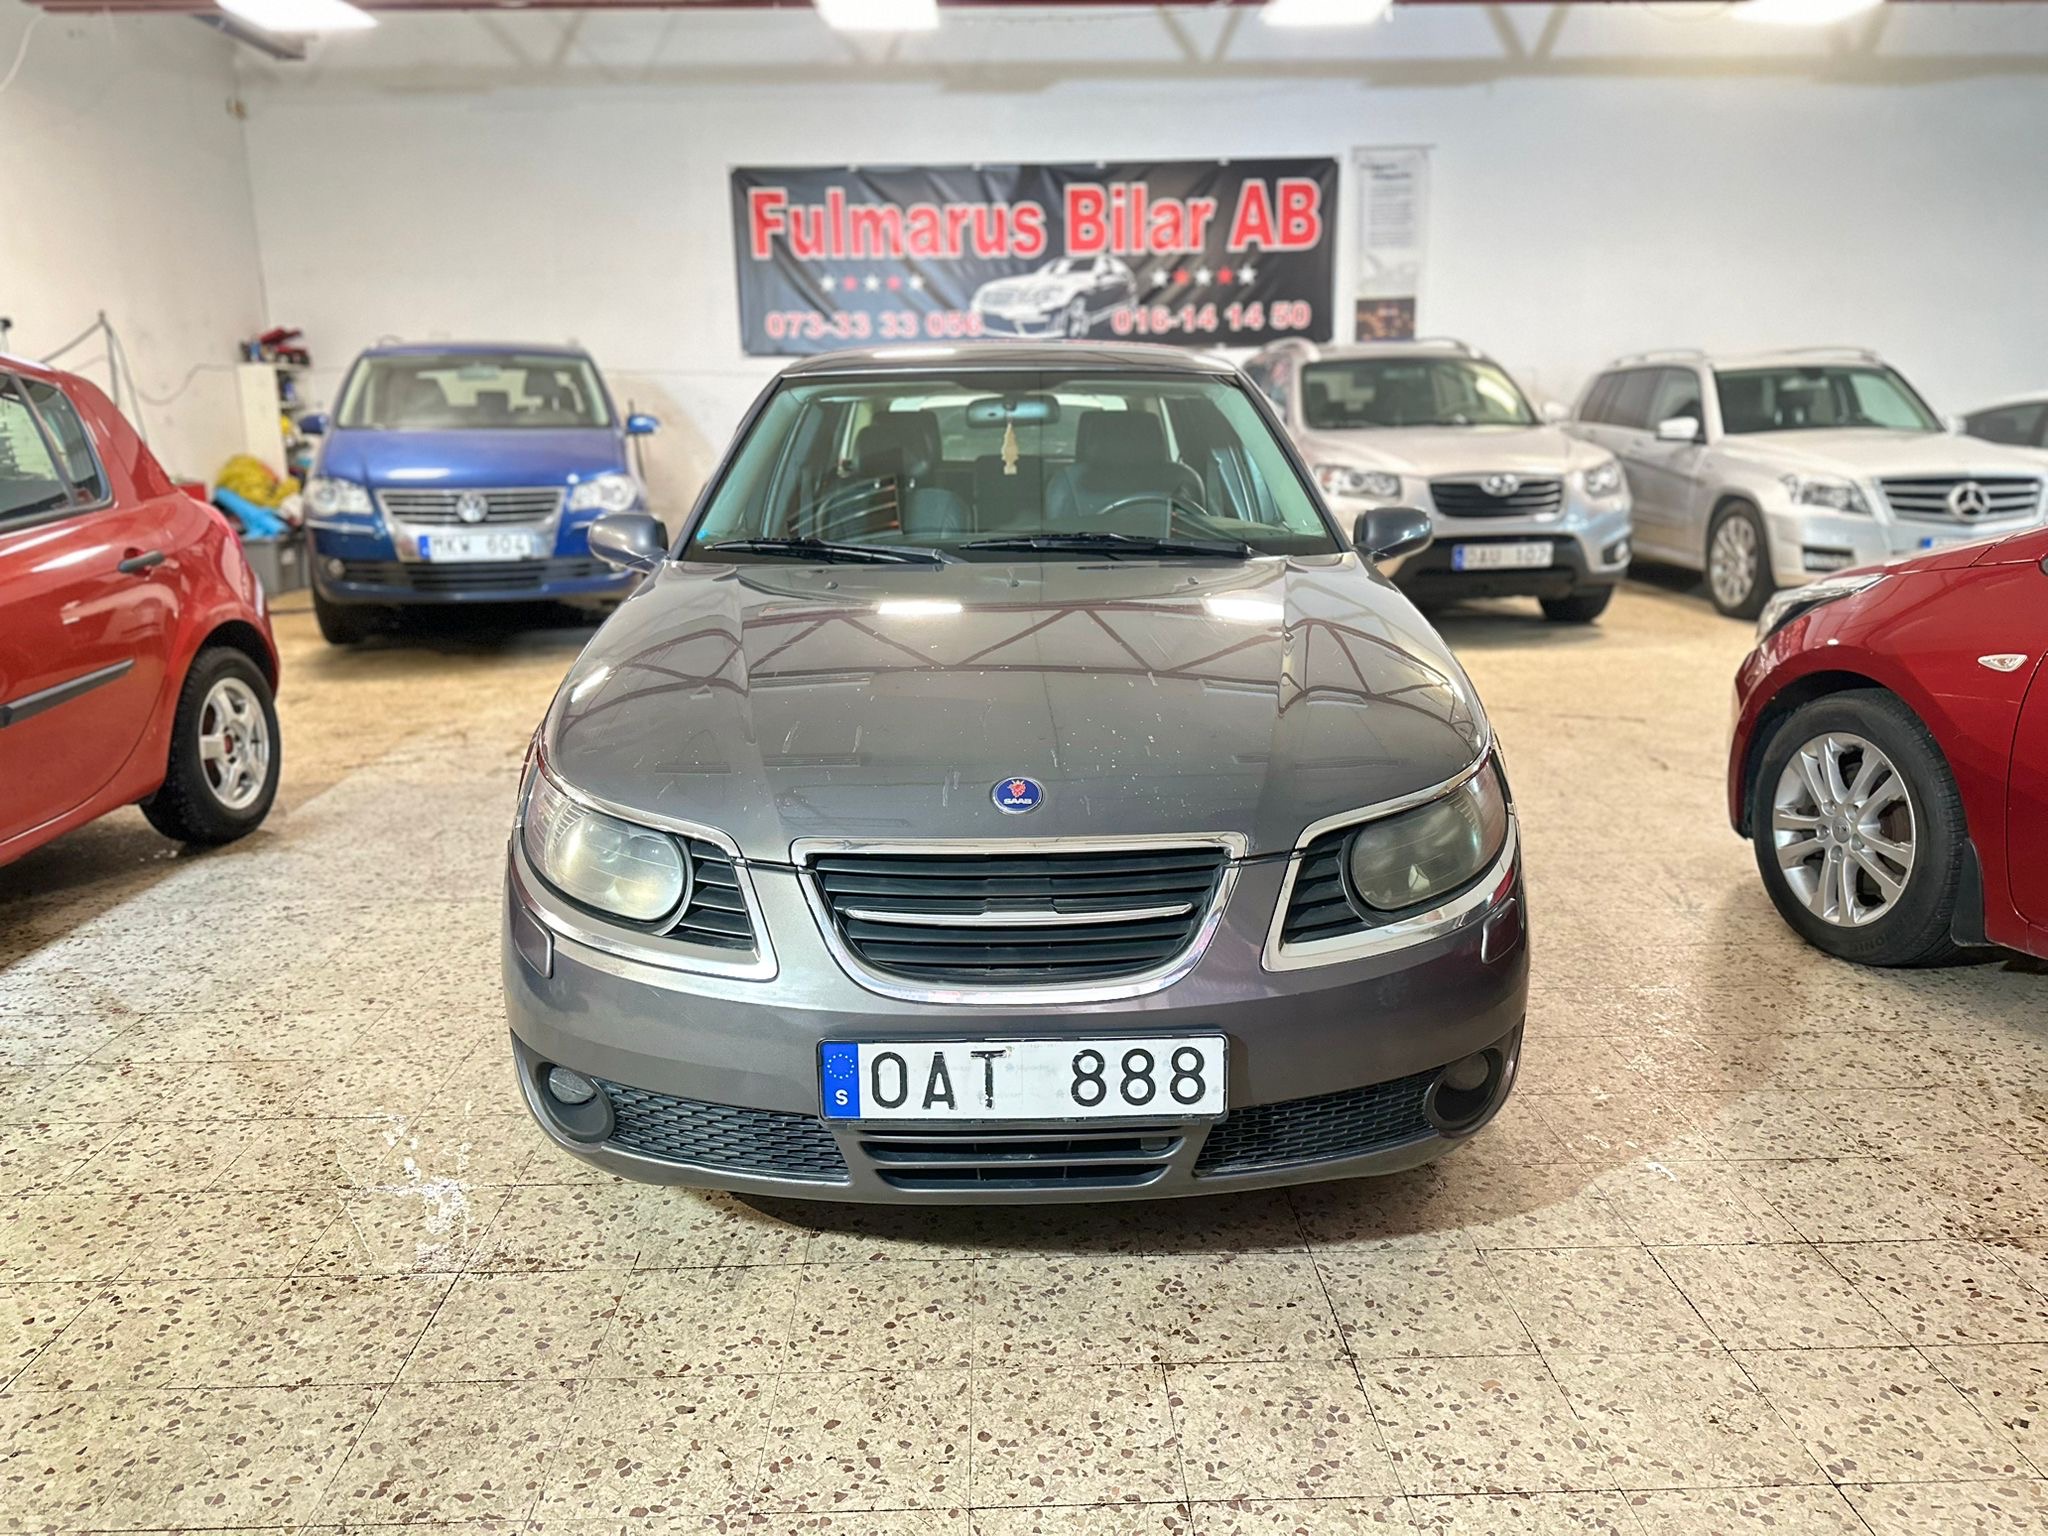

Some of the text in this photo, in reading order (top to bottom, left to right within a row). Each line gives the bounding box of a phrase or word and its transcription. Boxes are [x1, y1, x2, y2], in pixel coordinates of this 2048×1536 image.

[748, 186, 1047, 260] Fulmarus
[1064, 181, 1217, 257] Bilar
[1227, 177, 1321, 252] AB
[765, 311, 872, 339] 073-33
[878, 312, 918, 339] 33
[1110, 300, 1312, 335] 016-14 14 50
[1003, 797, 1033, 805] SAAB
[871, 1046, 1206, 1110] OAT 888
[835, 1088, 848, 1105] S
